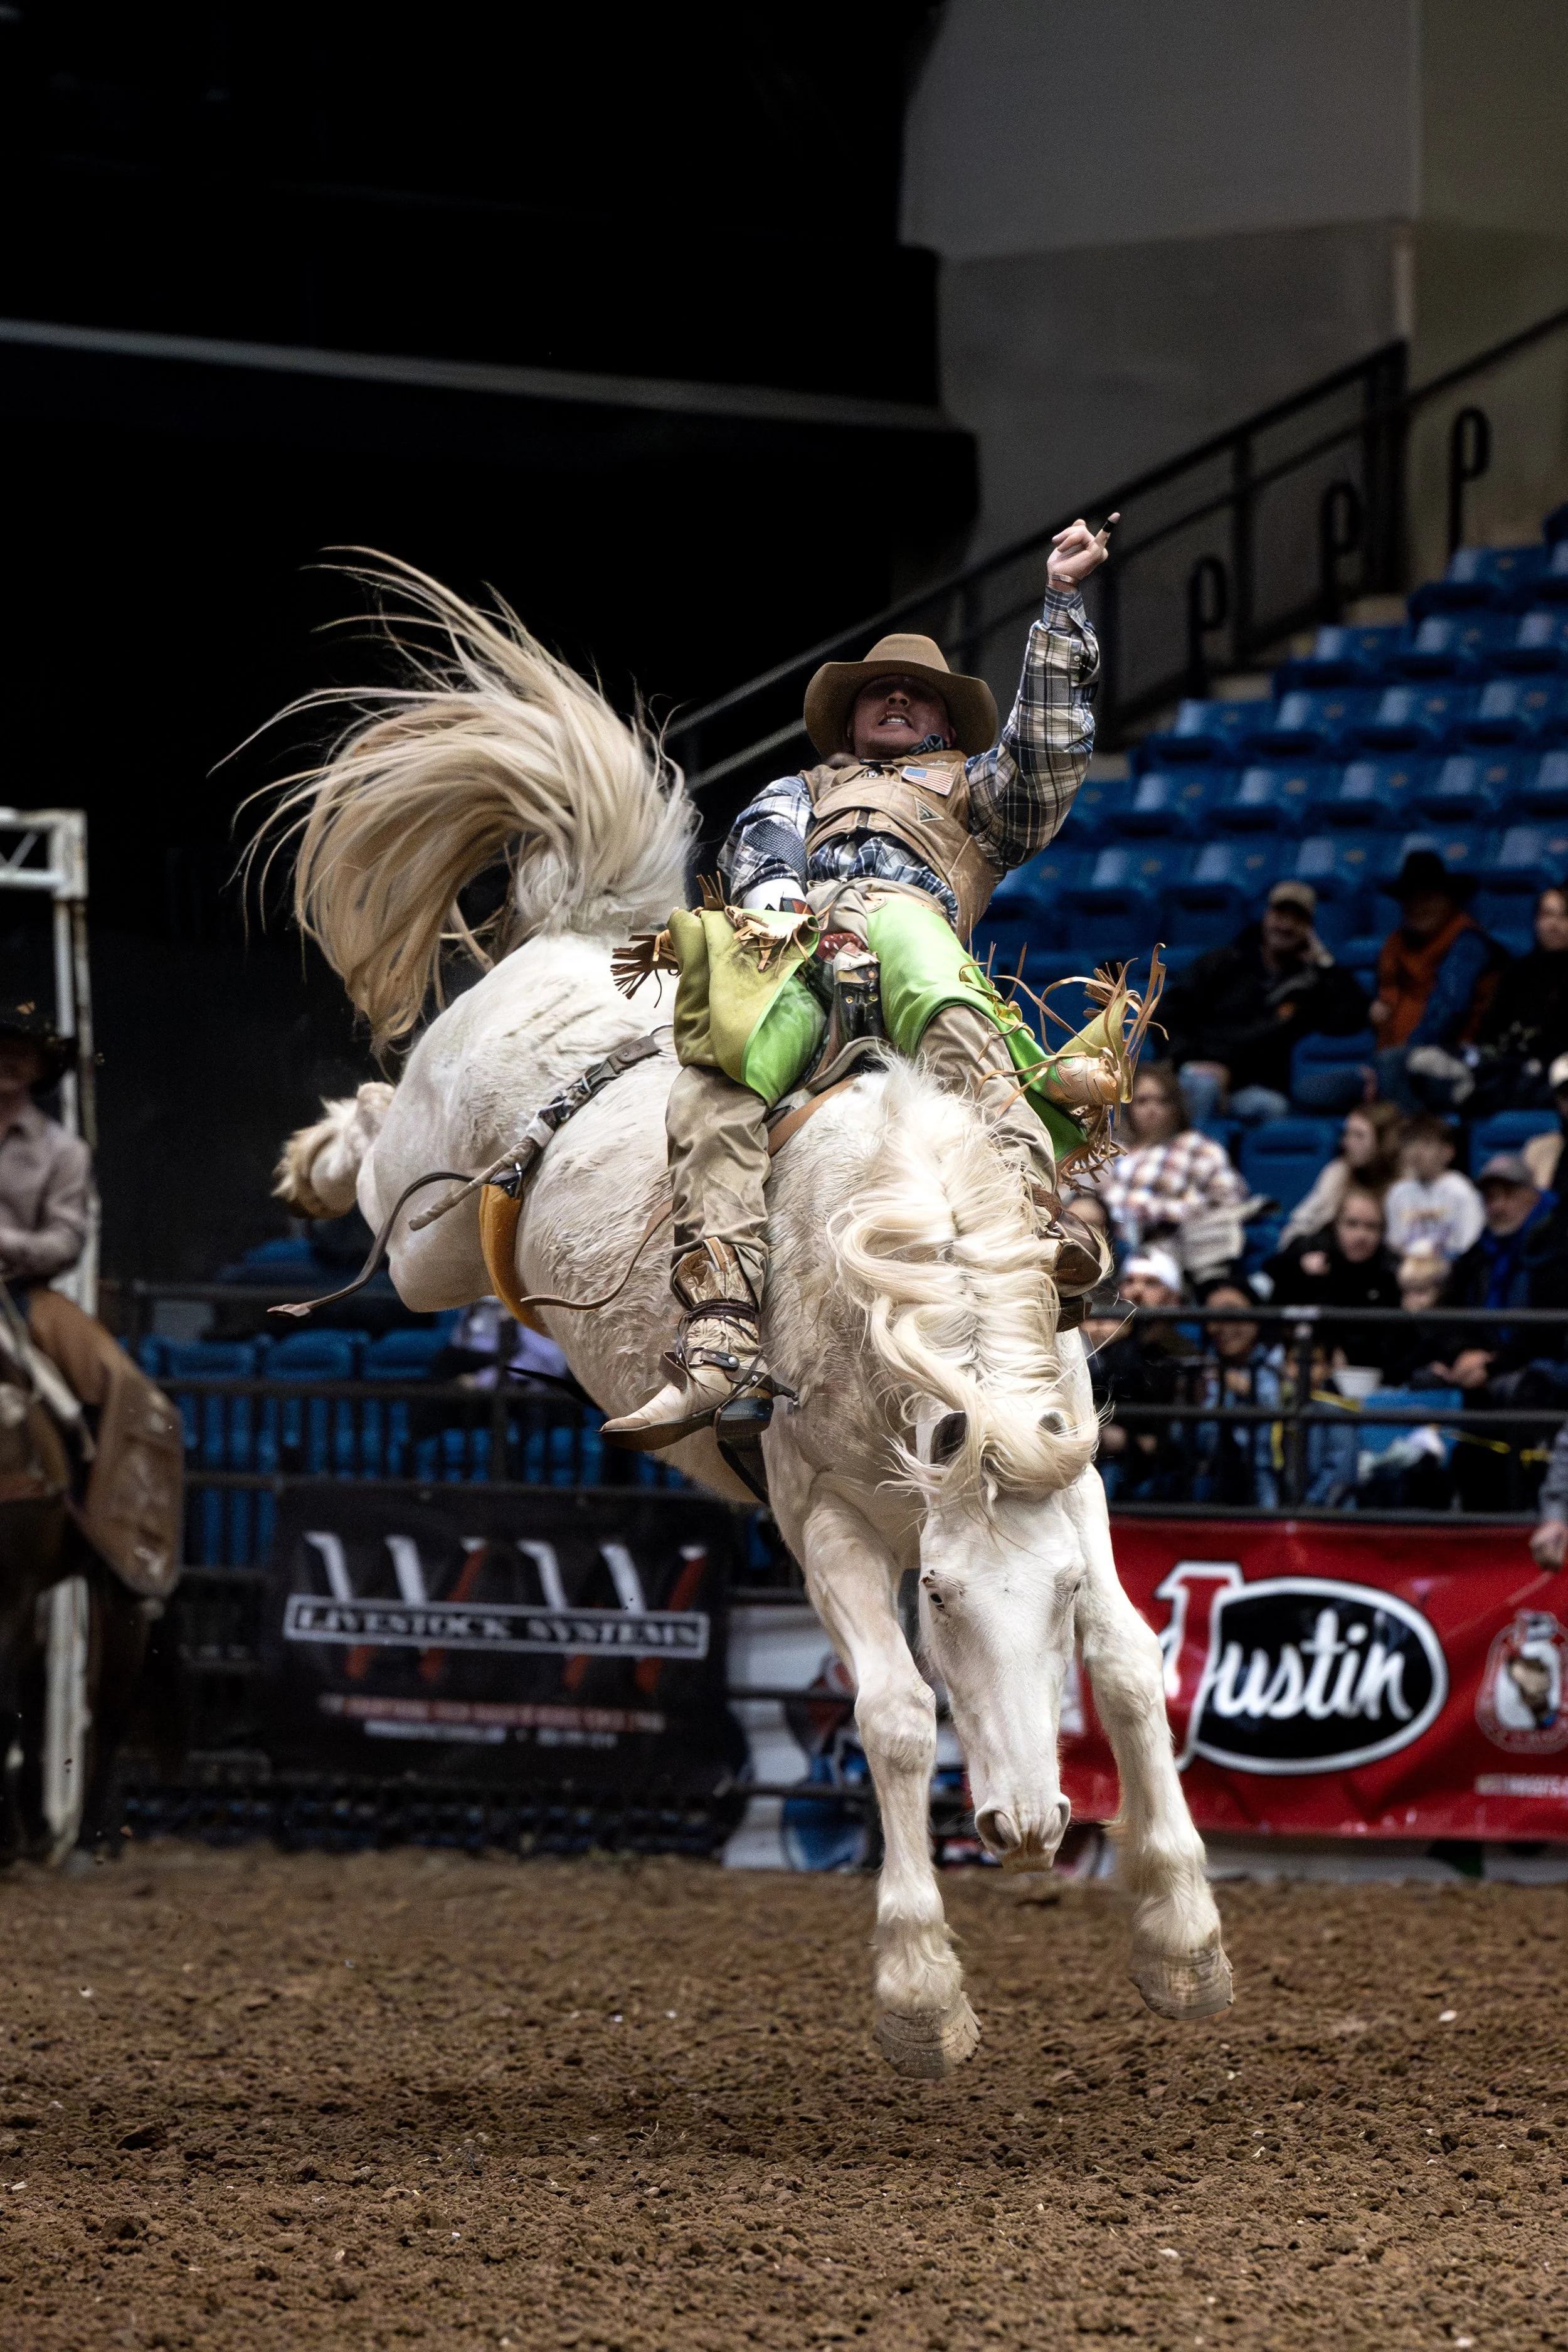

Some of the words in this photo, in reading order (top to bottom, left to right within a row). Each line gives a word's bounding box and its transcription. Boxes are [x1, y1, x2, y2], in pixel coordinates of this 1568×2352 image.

[297, 1608, 512, 1638] LIVESTOCK
[526, 1617, 697, 1645] SYSTEMS
[1153, 1560, 1415, 1772] Justin
